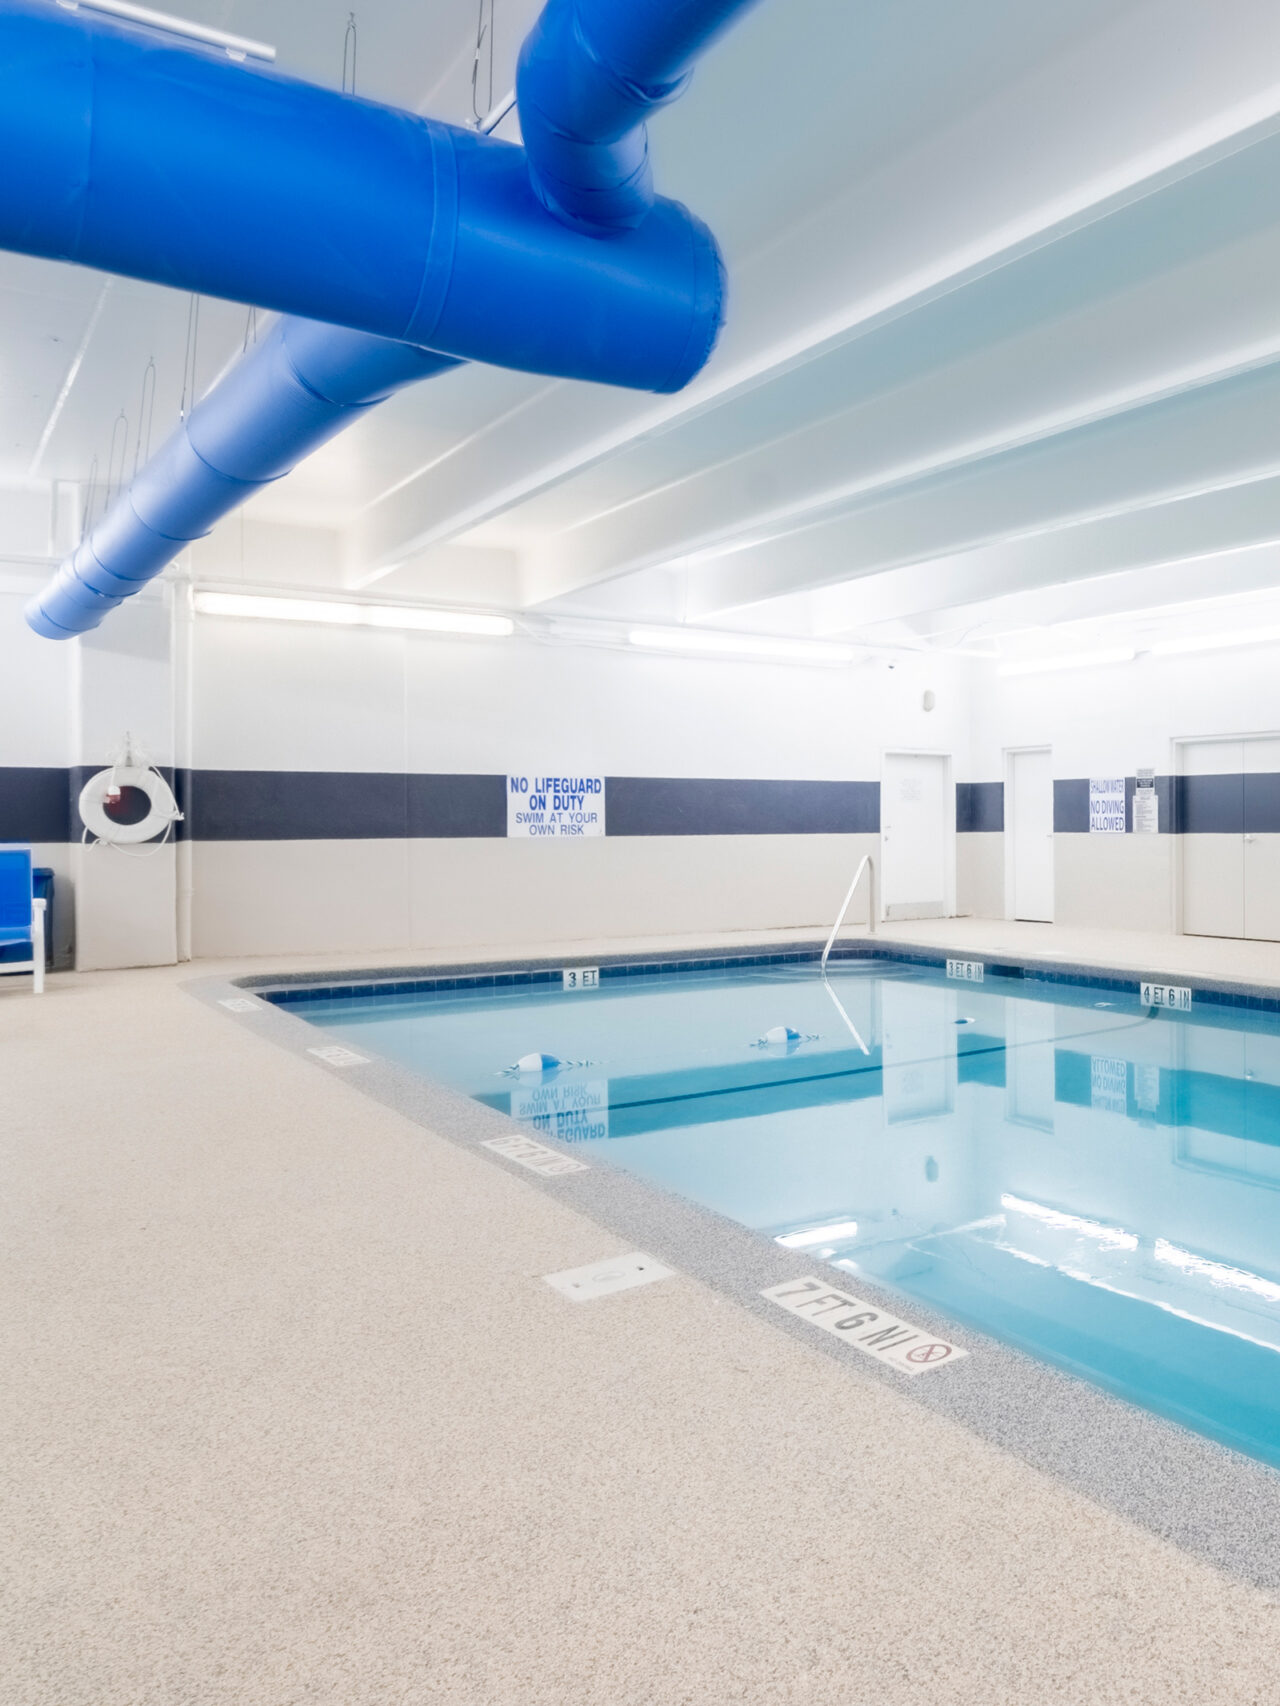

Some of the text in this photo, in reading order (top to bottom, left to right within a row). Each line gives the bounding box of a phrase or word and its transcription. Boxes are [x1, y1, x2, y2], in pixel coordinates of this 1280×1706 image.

[510, 777, 602, 794] NO LIFEGUARD
[529, 794, 585, 811] ON DUTY
[1090, 800, 1124, 814] NO DIVING
[515, 812, 598, 824] SWIM AT YOUR
[1091, 817, 1125, 831] ALLOWED
[529, 824, 585, 836] OWN RISK
[568, 971, 577, 985] 3
[775, 1281, 822, 1298] 7
[794, 1293, 856, 1317] FT
[833, 1311, 879, 1331] 6
